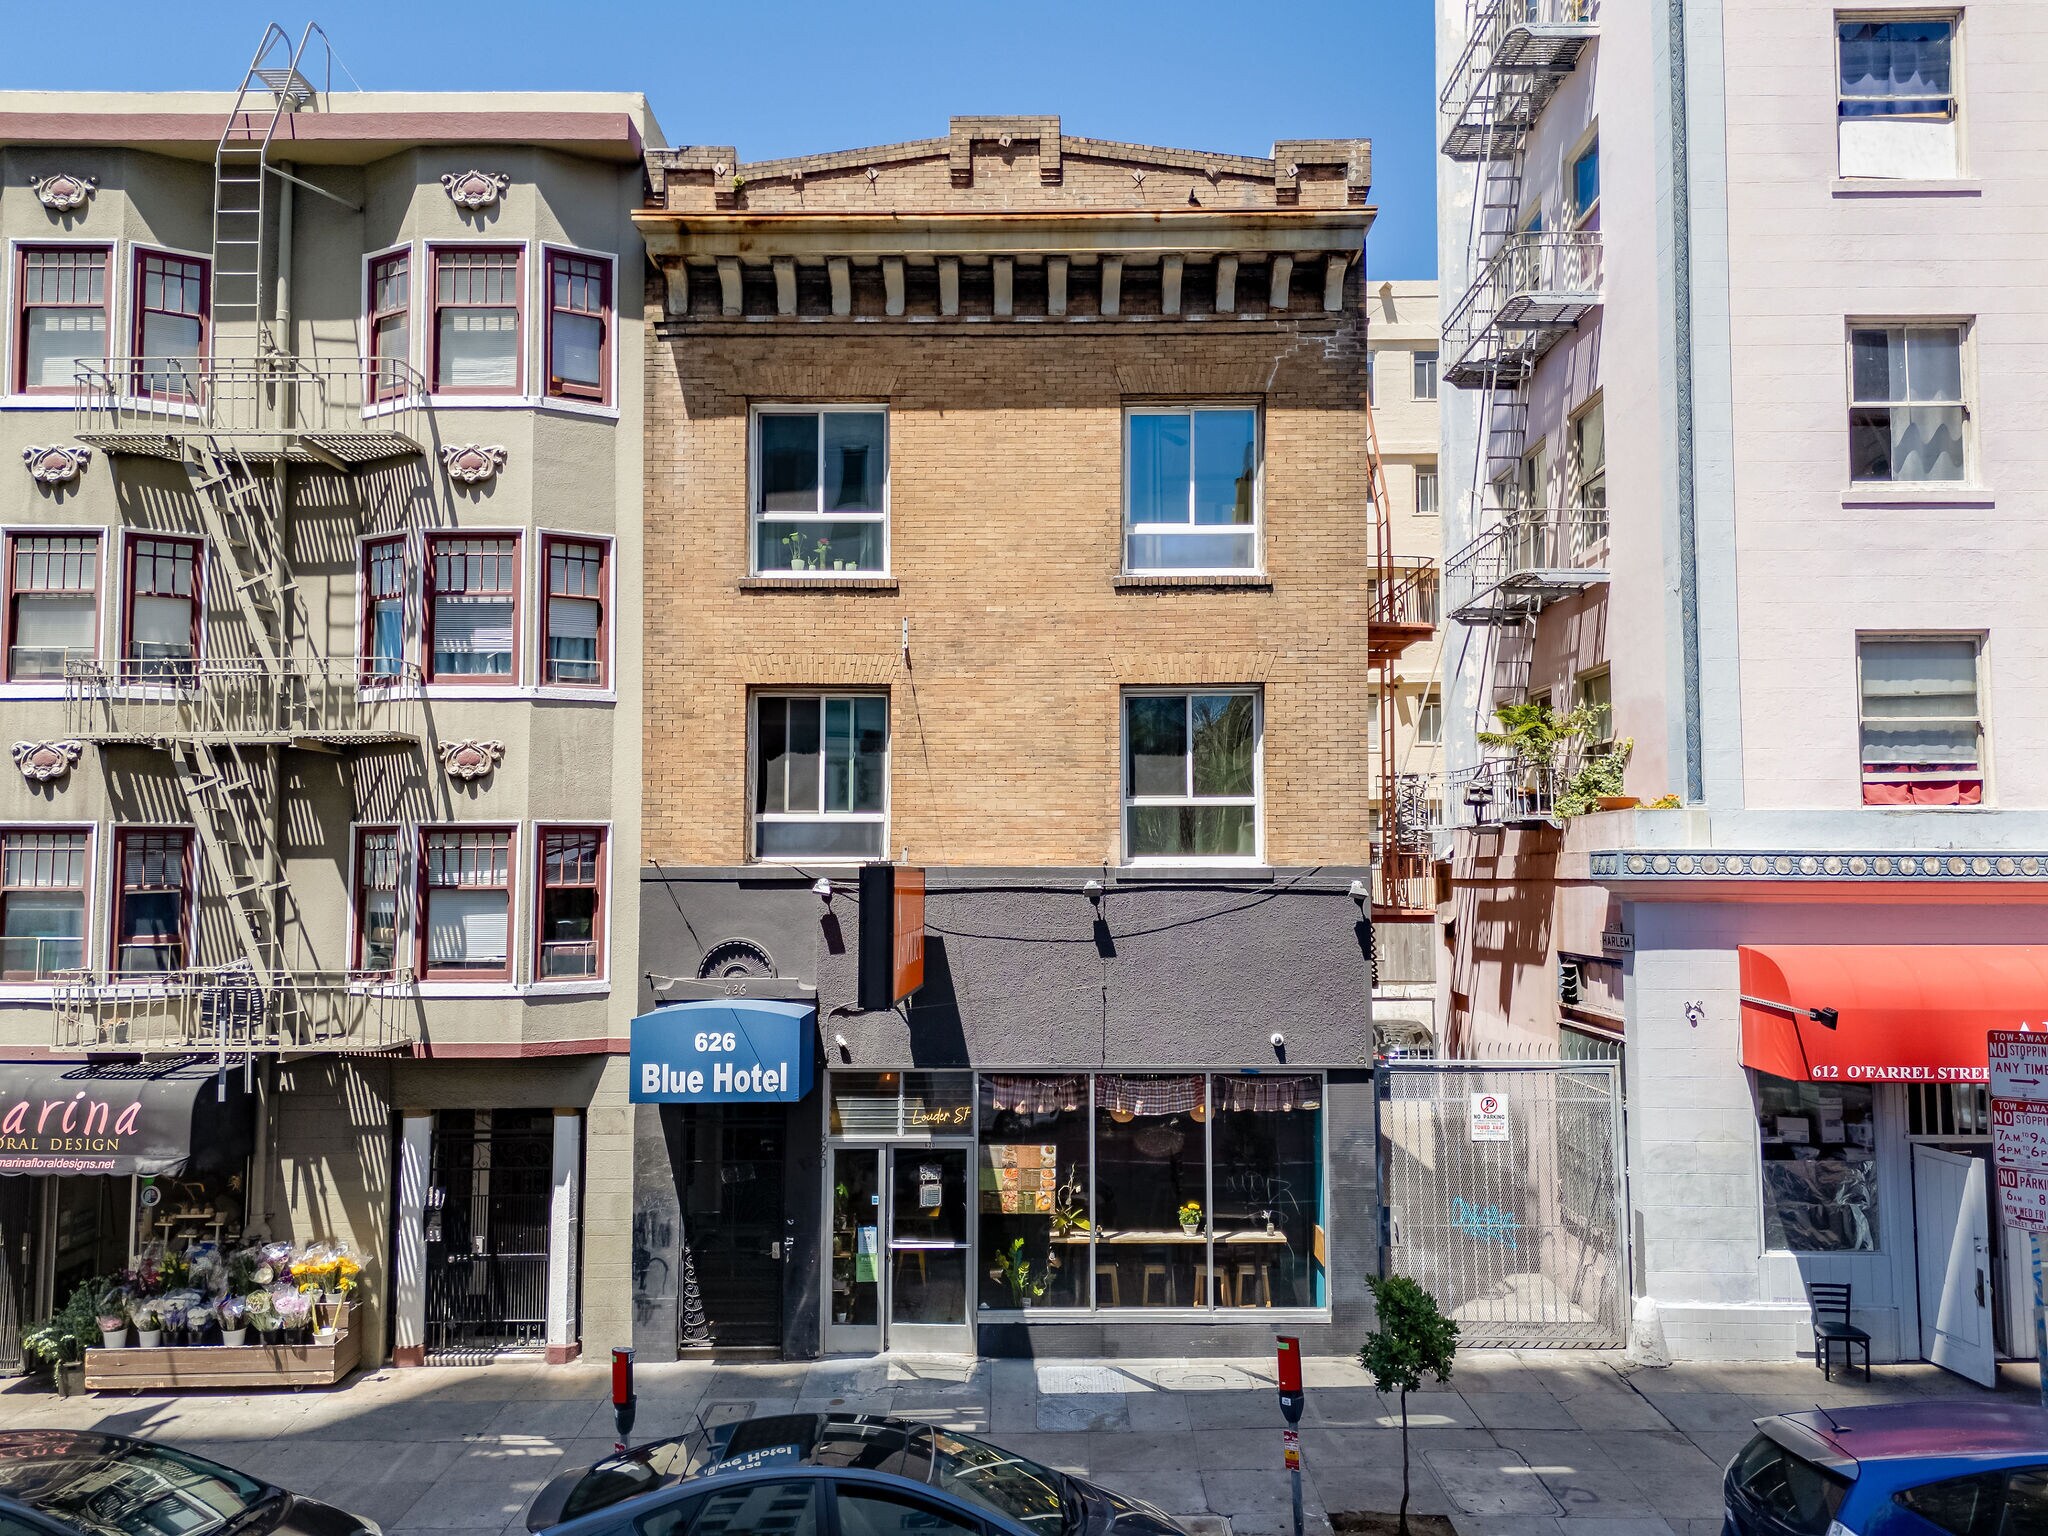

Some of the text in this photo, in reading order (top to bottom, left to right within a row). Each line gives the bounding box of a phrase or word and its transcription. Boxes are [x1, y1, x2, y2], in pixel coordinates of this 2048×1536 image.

[1602, 935, 1630, 948] HARLEM
[724, 983, 747, 995] 626
[694, 1032, 736, 1052] 626
[1993, 1032, 2048, 1043] TOW-AWAY
[1990, 1042, 2048, 1058] NO STOPPIN
[1812, 1065, 1990, 1080] 612 O'FARREL STREE
[1995, 1062, 2048, 1075] ANY TIME
[641, 1062, 788, 1094] Blue Hotel
[0, 1091, 142, 1135] arina
[2025, 1104, 2048, 1113] AWA
[912, 1107, 951, 1125] Louder
[1993, 1110, 2013, 1124] NO
[0, 1138, 120, 1151] RAL DESIGN
[2000, 1170, 2048, 1191] NO PARKI
[2004, 1205, 2047, 1220] MON WED FRI
[2030, 1222, 2048, 1231] CLEA
